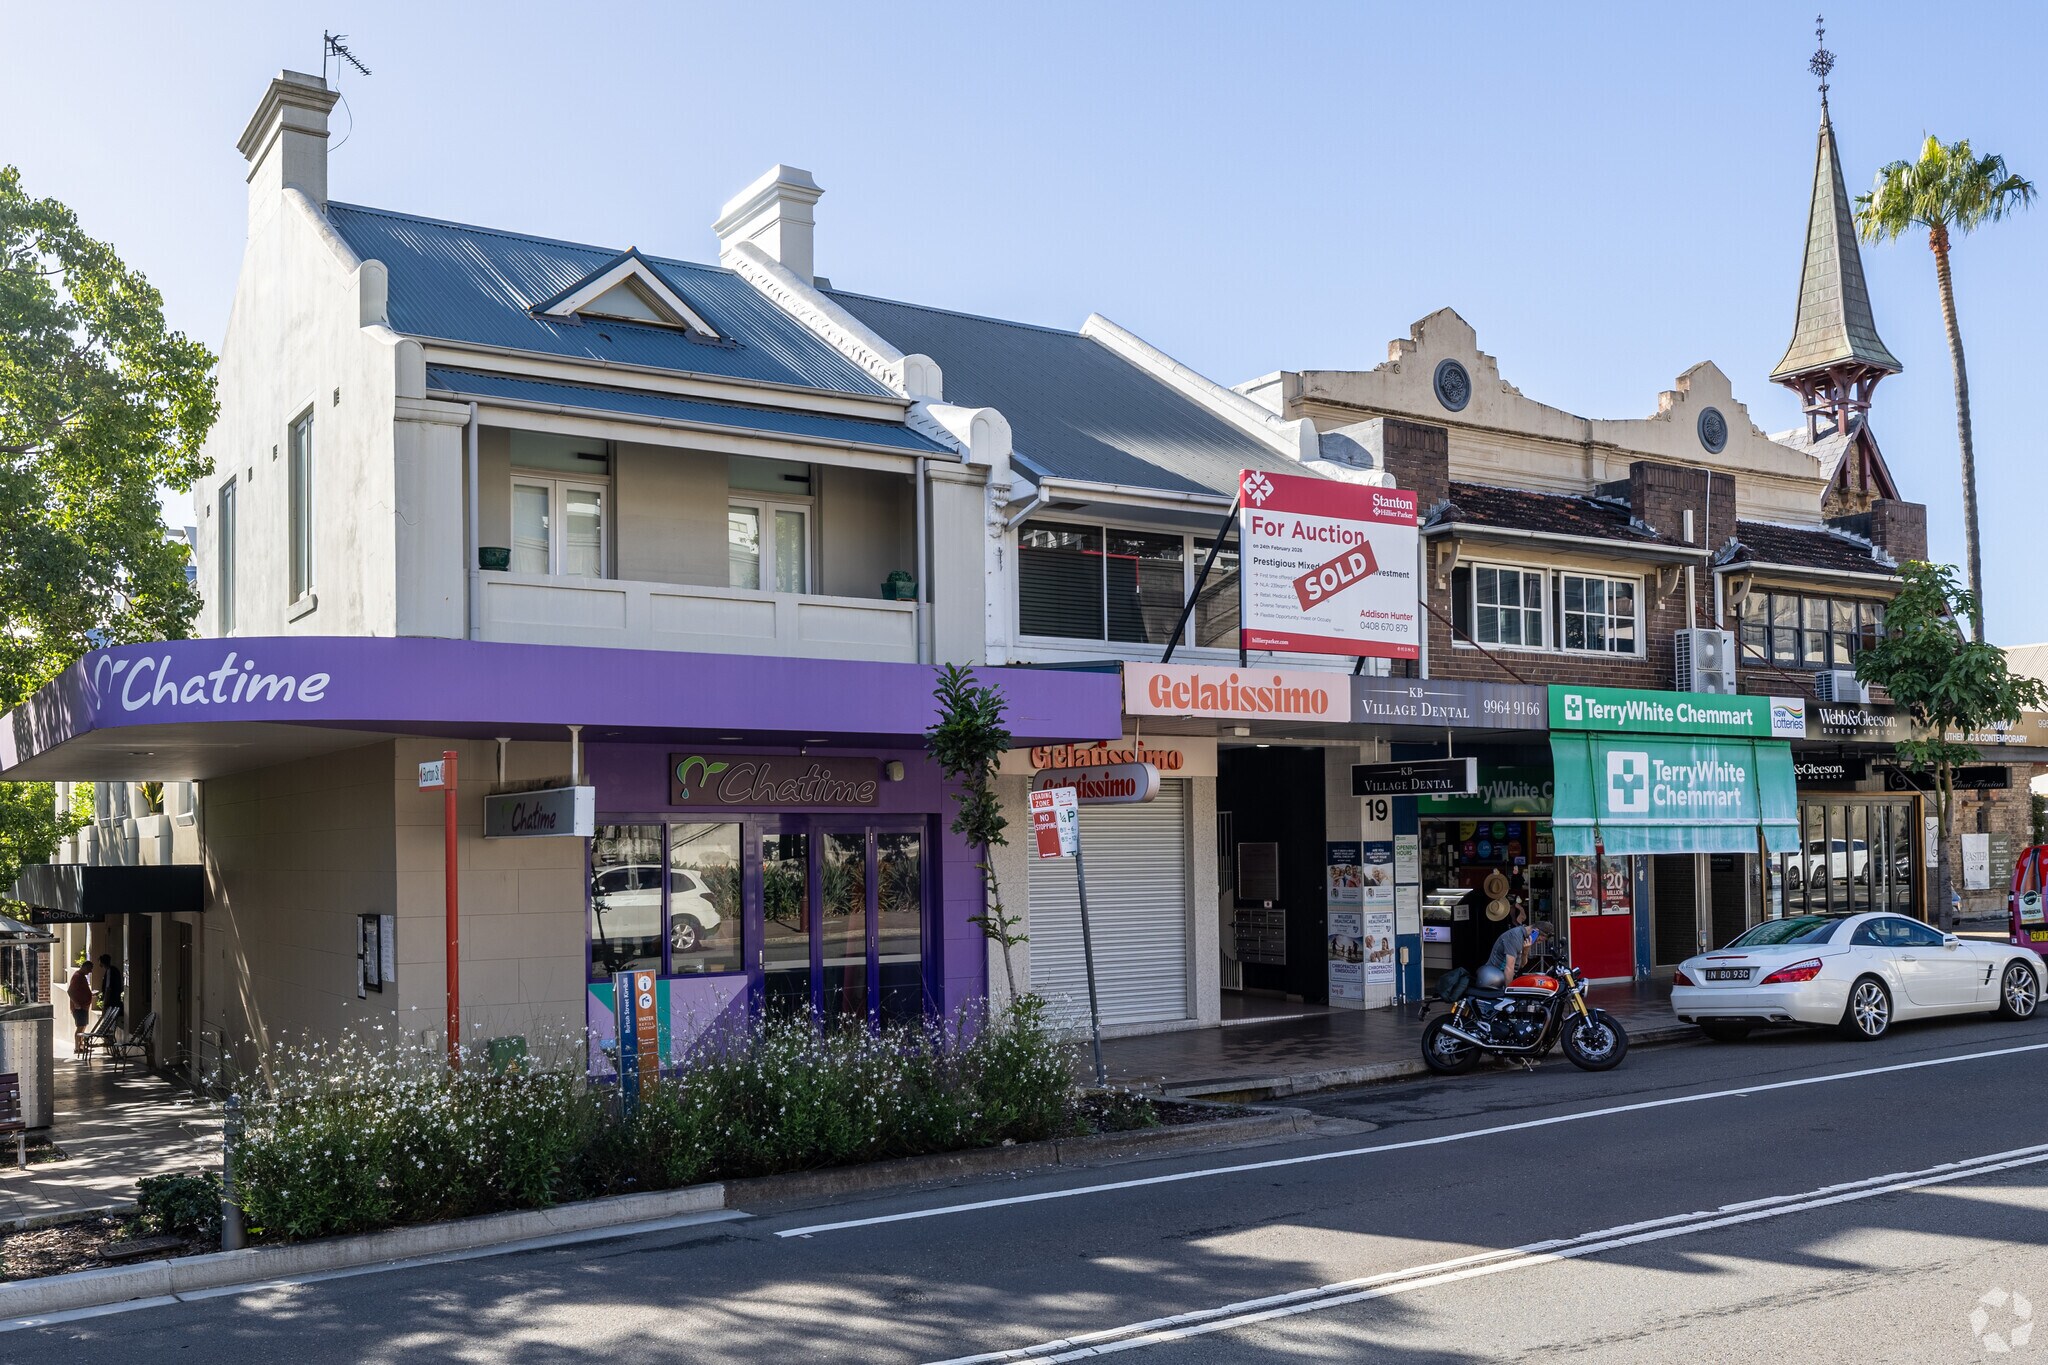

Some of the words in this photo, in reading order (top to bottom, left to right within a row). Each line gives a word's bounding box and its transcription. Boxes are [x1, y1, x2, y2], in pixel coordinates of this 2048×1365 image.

[1372, 493, 1413, 510] Stanton
[1380, 509, 1397, 517] Hillier
[1397, 511, 1413, 519] Parker
[1252, 515, 1285, 538] For
[1291, 520, 1365, 546] Auction
[1253, 556, 1296, 569] Prestigious
[1297, 561, 1320, 570] Mixed
[1304, 552, 1367, 600] SOLD
[1360, 609, 1389, 619] Addison
[1390, 611, 1413, 621] Hunter
[1360, 621, 1380, 631] 0408
[1381, 622, 1394, 632] 670
[1395, 623, 1408, 633] 879
[121, 651, 331, 712] Chatime
[1148, 672, 1329, 715] Gelatissimo
[1408, 687, 1424, 698] KB
[1362, 699, 1417, 717] VILLAGE
[1421, 702, 1470, 719] DENTAL
[1483, 699, 1511, 714] 9964
[1513, 701, 1540, 716] 9166
[1585, 698, 1674, 726] TerryWhite
[1676, 703, 1754, 726] Chemmart
[1773, 717, 1804, 730] Lotteries
[1823, 727, 1857, 735] BUYERS
[1863, 728, 1896, 736] AGENCY
[1975, 733, 1980, 742] &
[1980, 733, 2028, 744] CONTEMPORARY
[1030, 740, 1184, 771] Gelatissimo
[422, 766, 435, 783] Burton
[1400, 766, 1413, 776] KB
[1652, 759, 1746, 788] TerryWhite
[717, 762, 877, 804] Chatime
[1973, 779, 2005, 788] Fusion
[1031, 791, 1052, 801] LOADING
[1035, 799, 1051, 808] ZONE
[1652, 783, 1742, 807] Chemmart
[511, 802, 557, 832] Chatime
[1039, 813, 1050, 823] NO
[1365, 799, 1388, 822] 19
[1035, 821, 1057, 831] STOPPING
[1964, 851, 1987, 862] EASTER
[1603, 872, 1624, 890] $20
